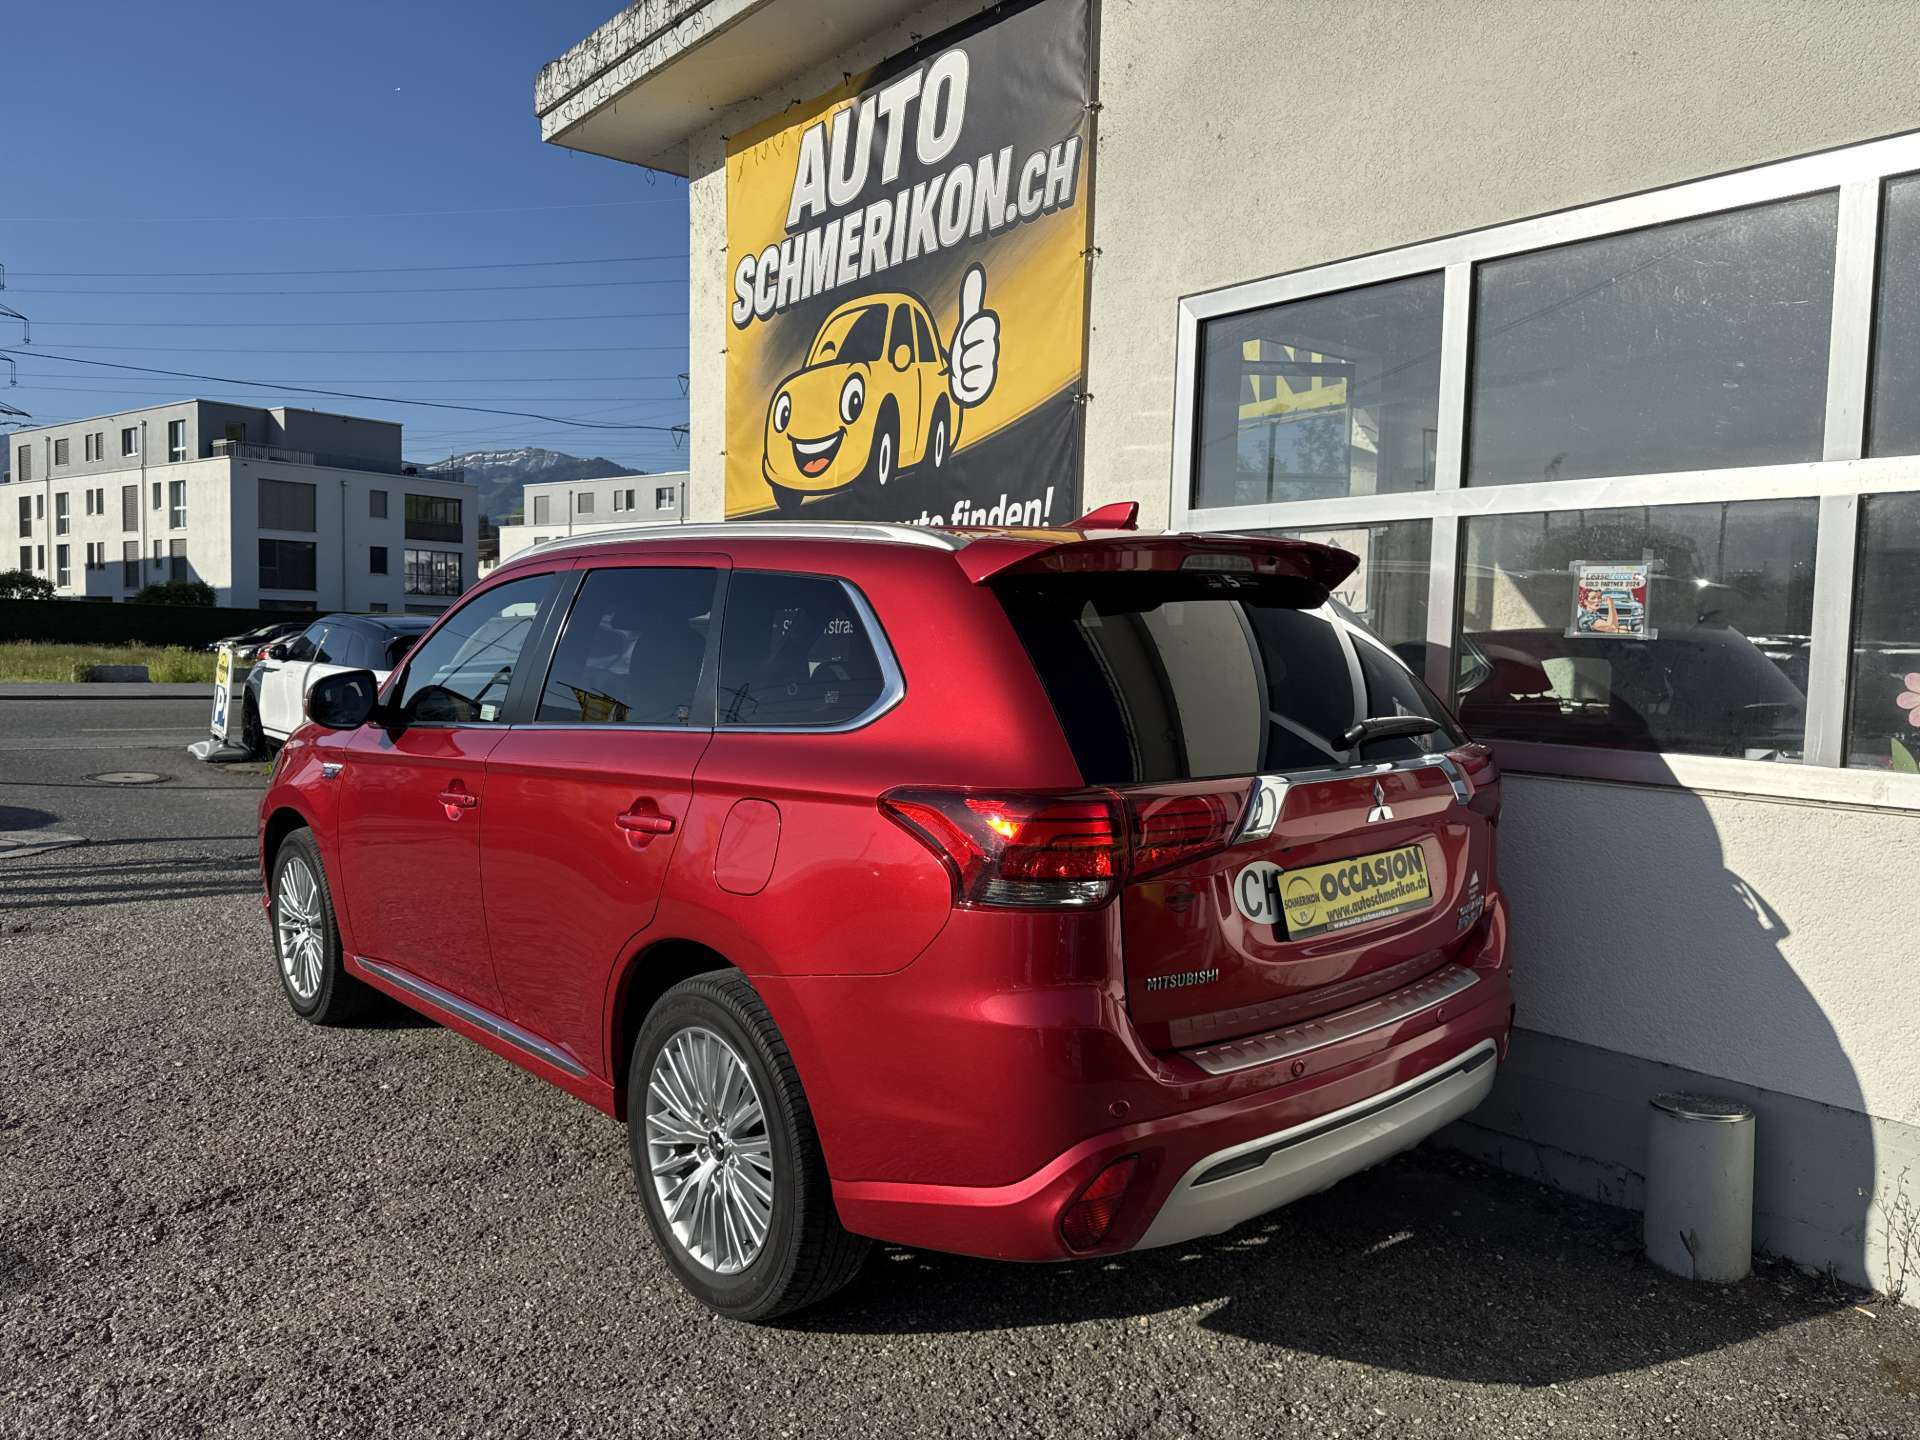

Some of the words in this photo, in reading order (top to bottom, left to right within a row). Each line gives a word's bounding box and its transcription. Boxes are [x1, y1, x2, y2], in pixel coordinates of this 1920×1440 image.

[786, 48, 970, 229] AUTO
[732, 136, 1082, 327] SCHMERIKON.CH
[951, 486, 1054, 527] finden!
[1241, 869, 1280, 918] CH
[1320, 847, 1424, 902] OCCASION
[1326, 874, 1427, 922] www.autoschmerikon.ch
[1146, 967, 1220, 991] MITSUBISHI
